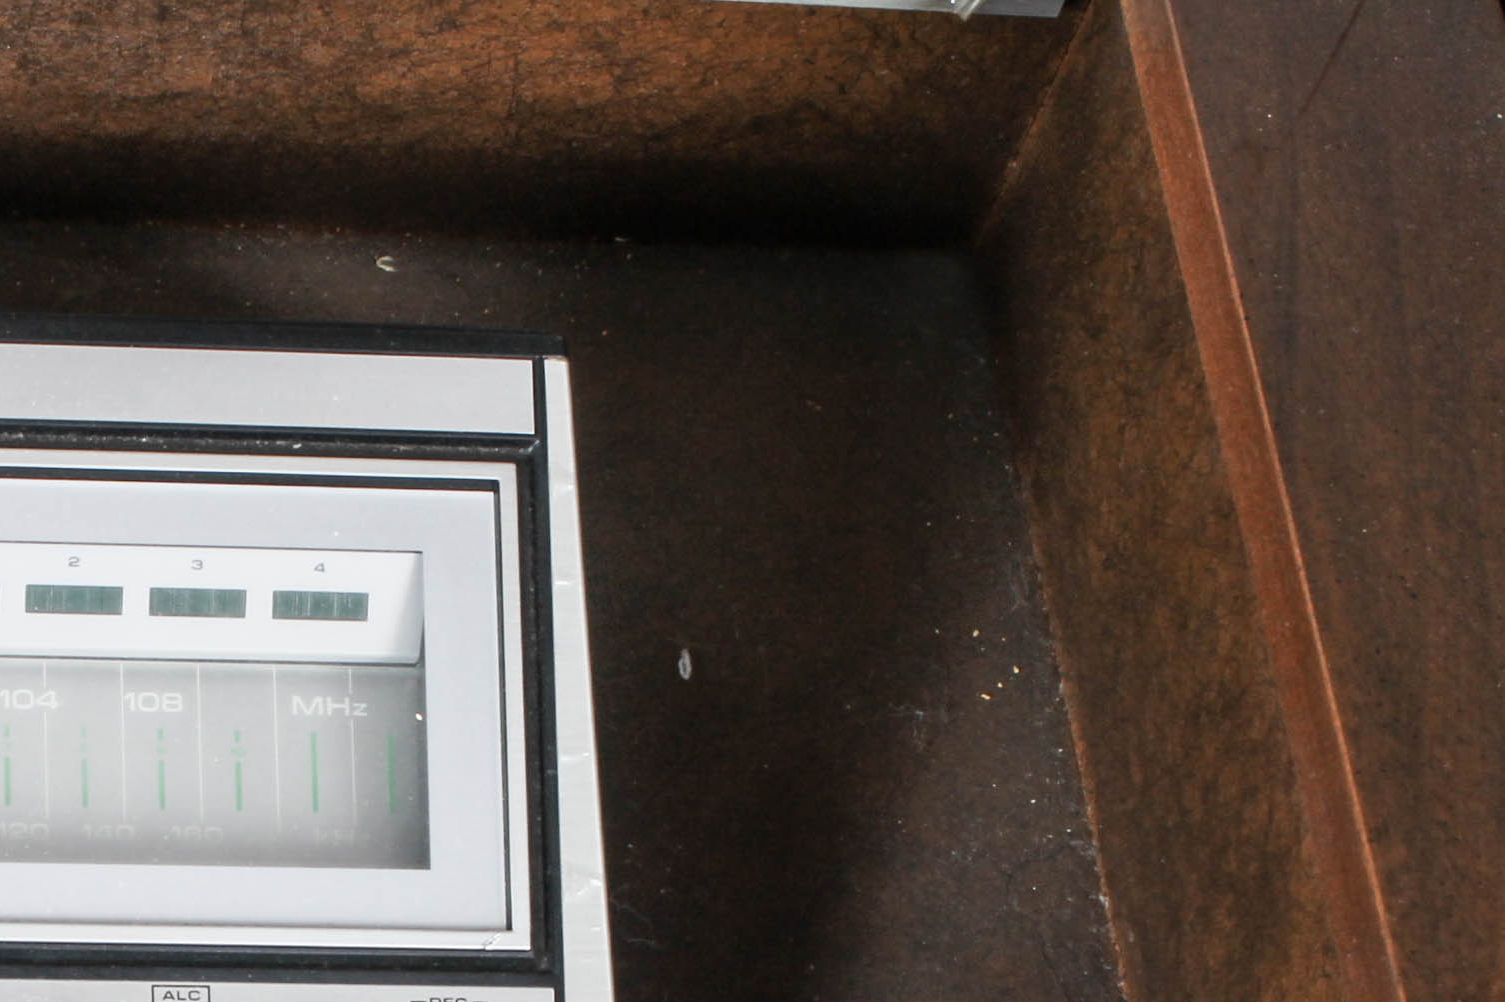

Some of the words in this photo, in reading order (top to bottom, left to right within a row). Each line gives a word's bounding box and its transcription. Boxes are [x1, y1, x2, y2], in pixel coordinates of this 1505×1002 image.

[68, 555, 80, 568] 2
[190, 559, 204, 571] 3
[313, 562, 326, 573] 4
[123, 691, 184, 713] 108
[291, 695, 368, 717] MHz
[162, 990, 201, 1002] ALC
